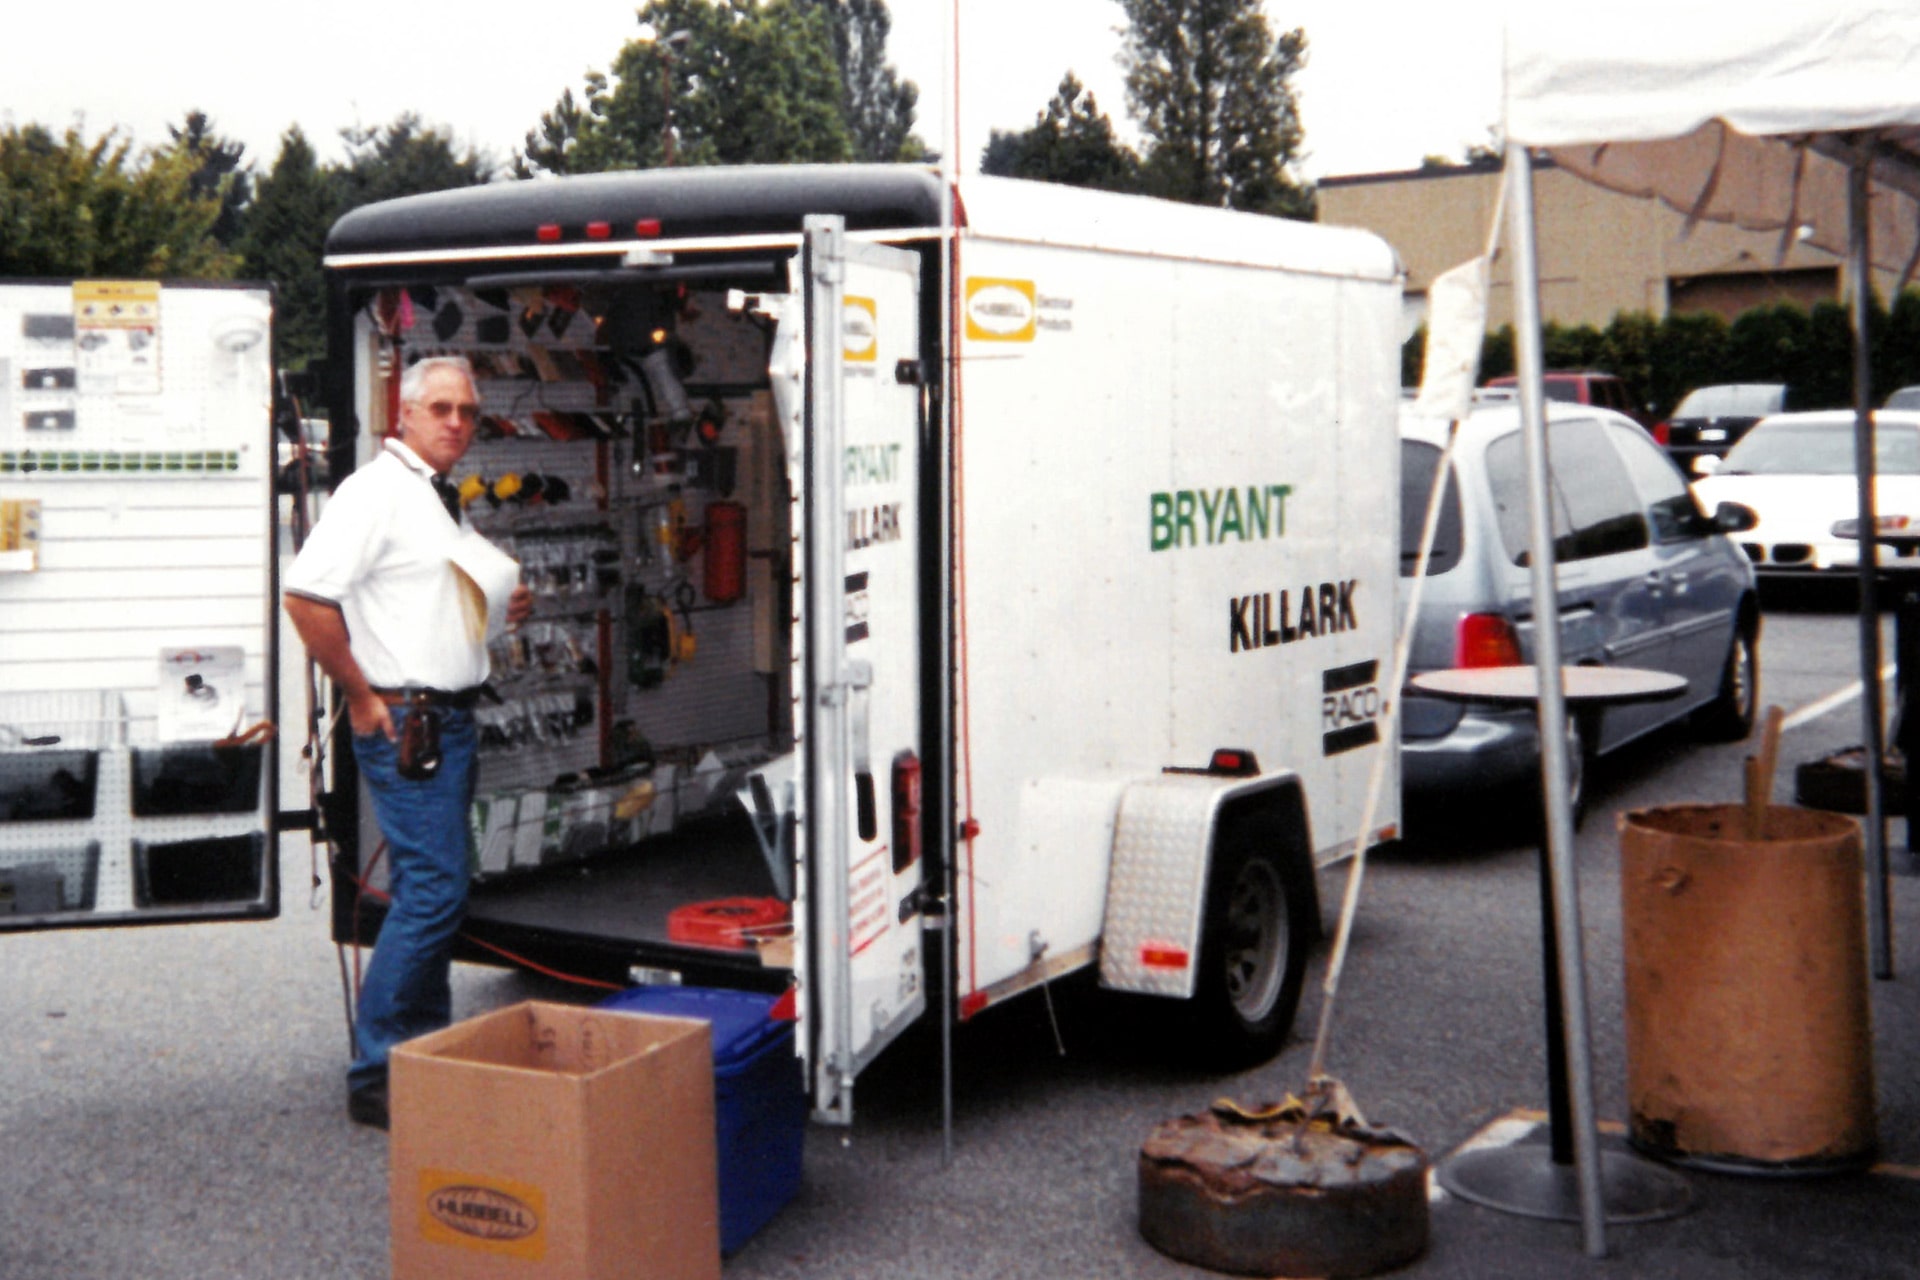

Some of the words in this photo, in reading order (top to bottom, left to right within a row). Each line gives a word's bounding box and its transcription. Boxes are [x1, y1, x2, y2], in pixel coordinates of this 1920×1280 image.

[845, 443, 900, 486] RYANT
[1150, 485, 1292, 552] BRYANT
[1229, 579, 1358, 653] KILLARK
[1322, 687, 1378, 728] RACO
[437, 1198, 529, 1229] HUBBELL
